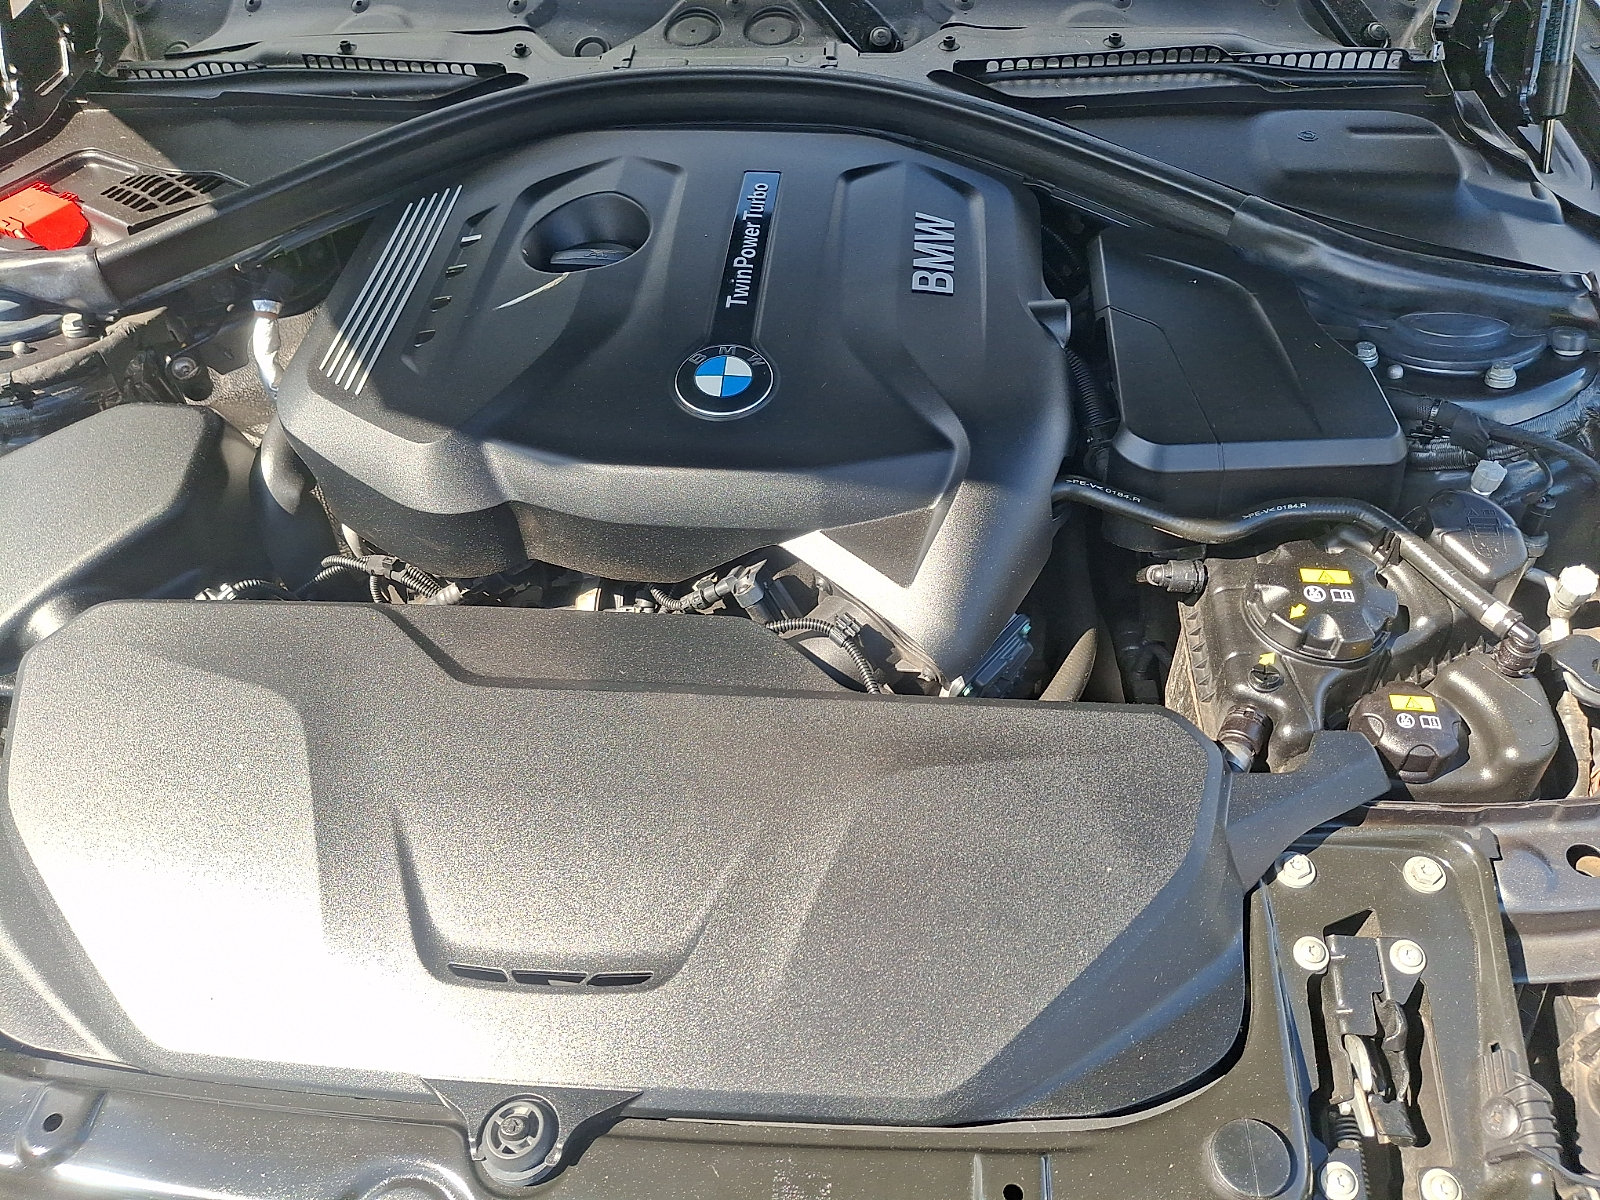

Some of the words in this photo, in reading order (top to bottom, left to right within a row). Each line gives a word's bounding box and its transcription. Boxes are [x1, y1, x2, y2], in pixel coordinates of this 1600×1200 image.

[742, 182, 769, 221] Turbo
[725, 221, 761, 309] TwinPower
[911, 211, 955, 296] BMW
[689, 345, 766, 366] BMW
[1276, 502, 1307, 511] 0184.R
